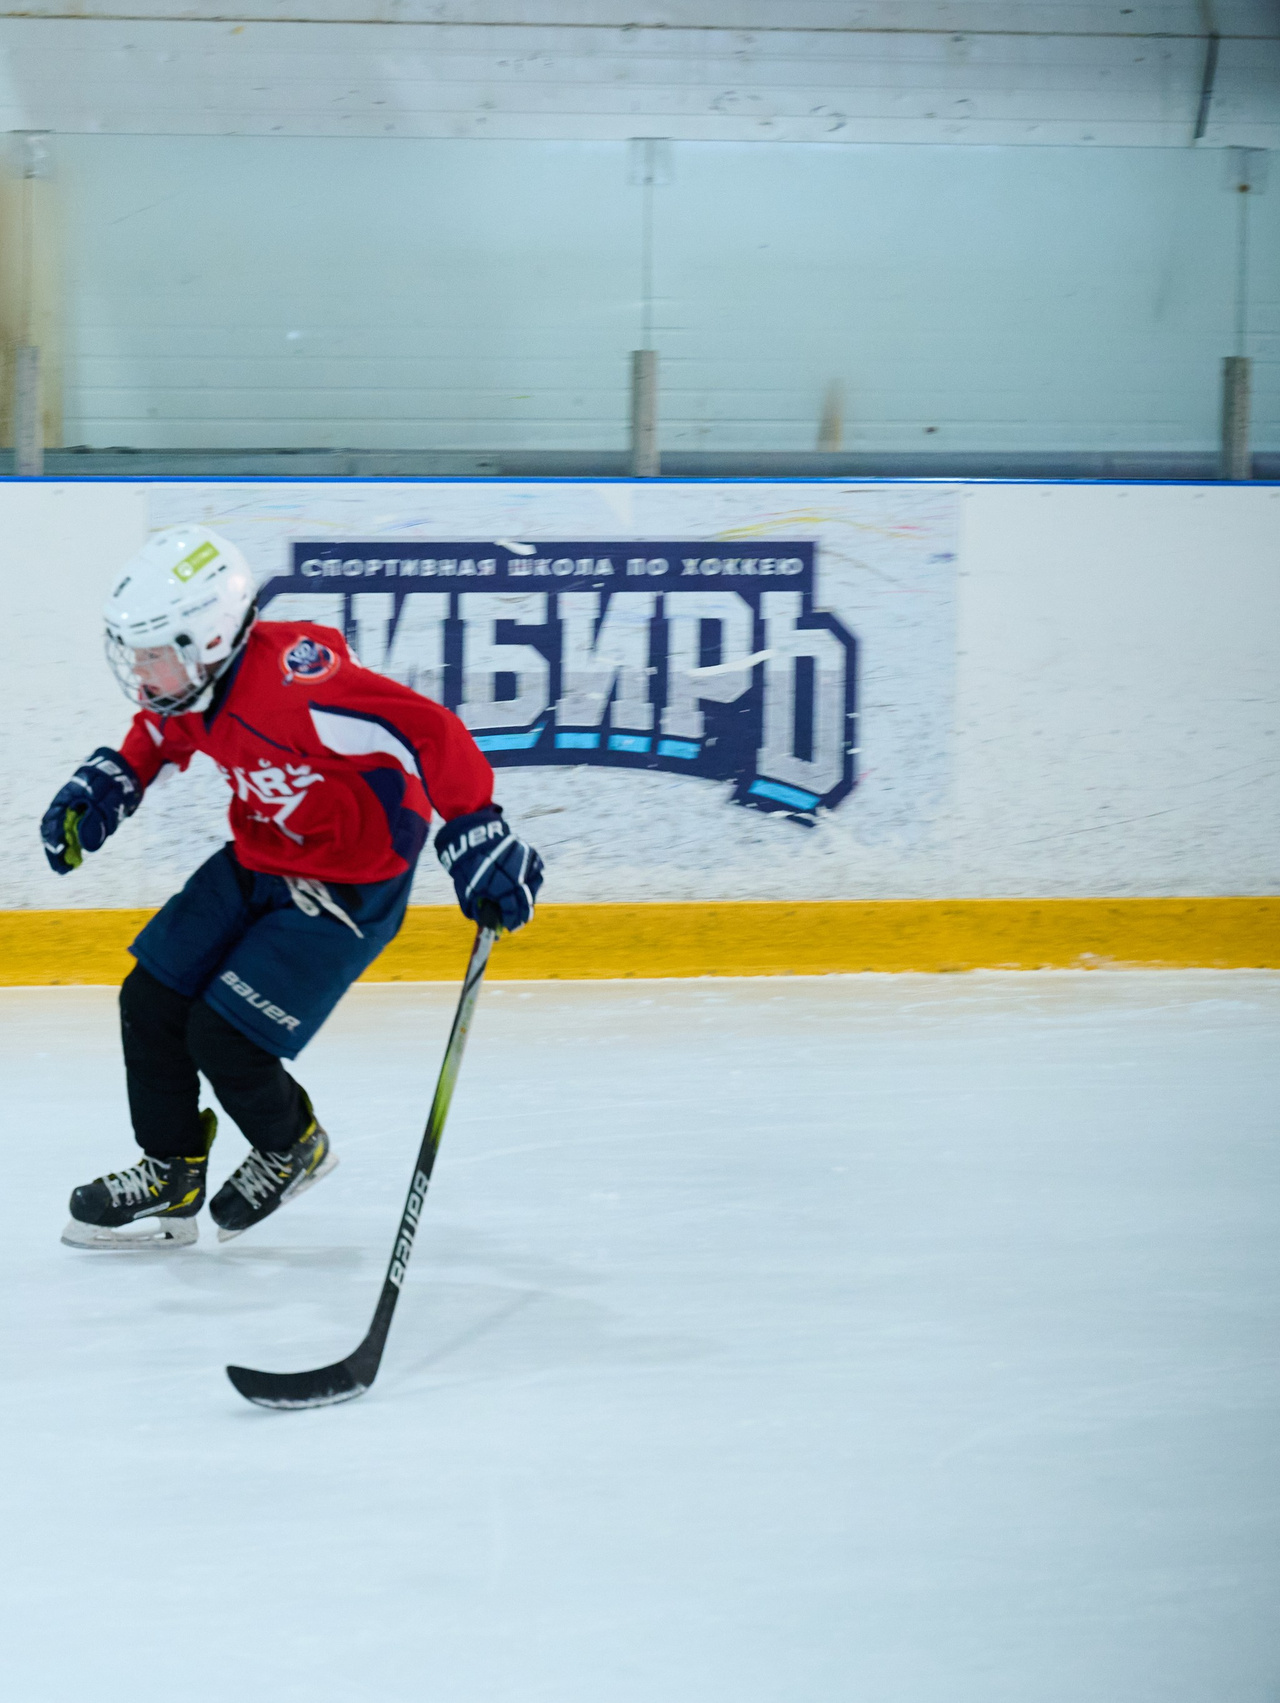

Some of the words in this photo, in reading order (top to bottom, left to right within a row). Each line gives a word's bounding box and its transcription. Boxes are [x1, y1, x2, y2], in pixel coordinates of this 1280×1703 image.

[300, 558, 497, 578] СПОРТИВНАЯ
[507, 558, 615, 577] ШКОЛА
[626, 557, 670, 576] ПО
[680, 557, 805, 576] ХОККЕЮ
[260, 591, 847, 795] ИБИРЬ
[439, 820, 505, 874] AUER
[219, 969, 303, 1033] BAUER
